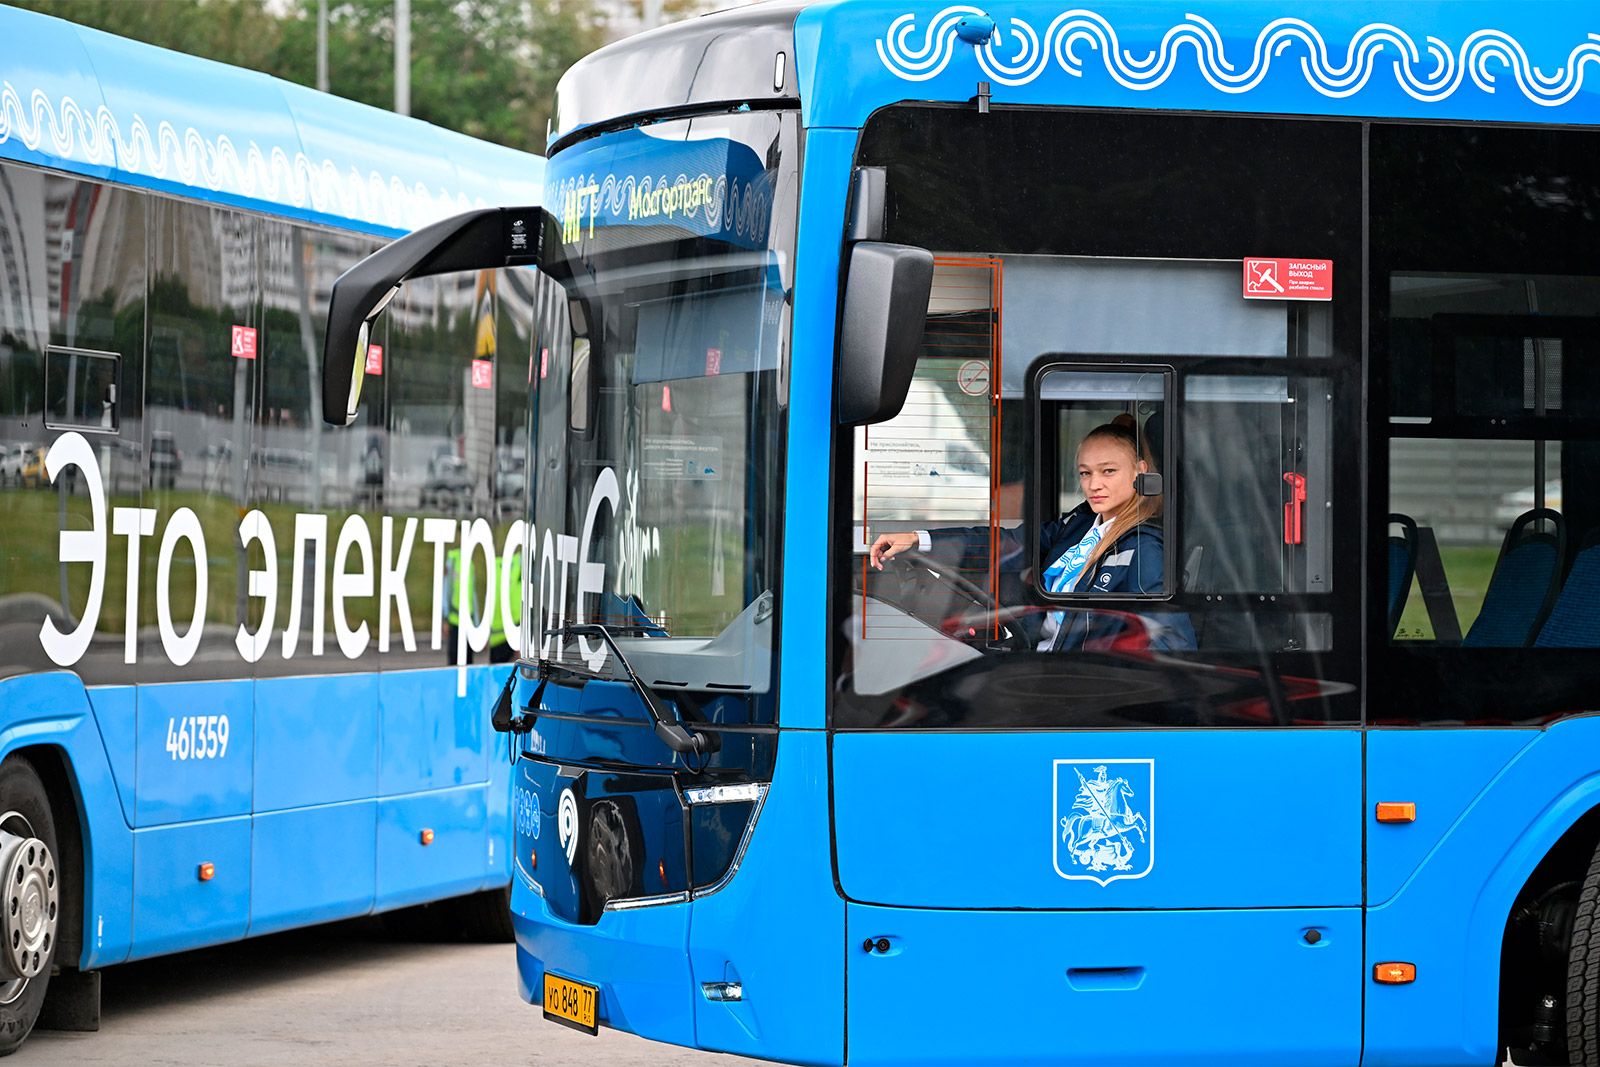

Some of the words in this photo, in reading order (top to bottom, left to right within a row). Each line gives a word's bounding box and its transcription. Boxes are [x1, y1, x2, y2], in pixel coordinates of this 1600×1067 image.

[562, 184, 599, 244] МГТ
[628, 176, 713, 221] Мосгортранс
[1288, 262, 1326, 270] ЗАПАСНЫЙ
[1288, 270, 1313, 278] ВЫХОД
[38, 431, 208, 667] Это
[165, 714, 230, 762] 461359
[548, 986, 559, 1010] УО
[562, 984, 579, 1017] 848
[583, 989, 592, 1013] 77
